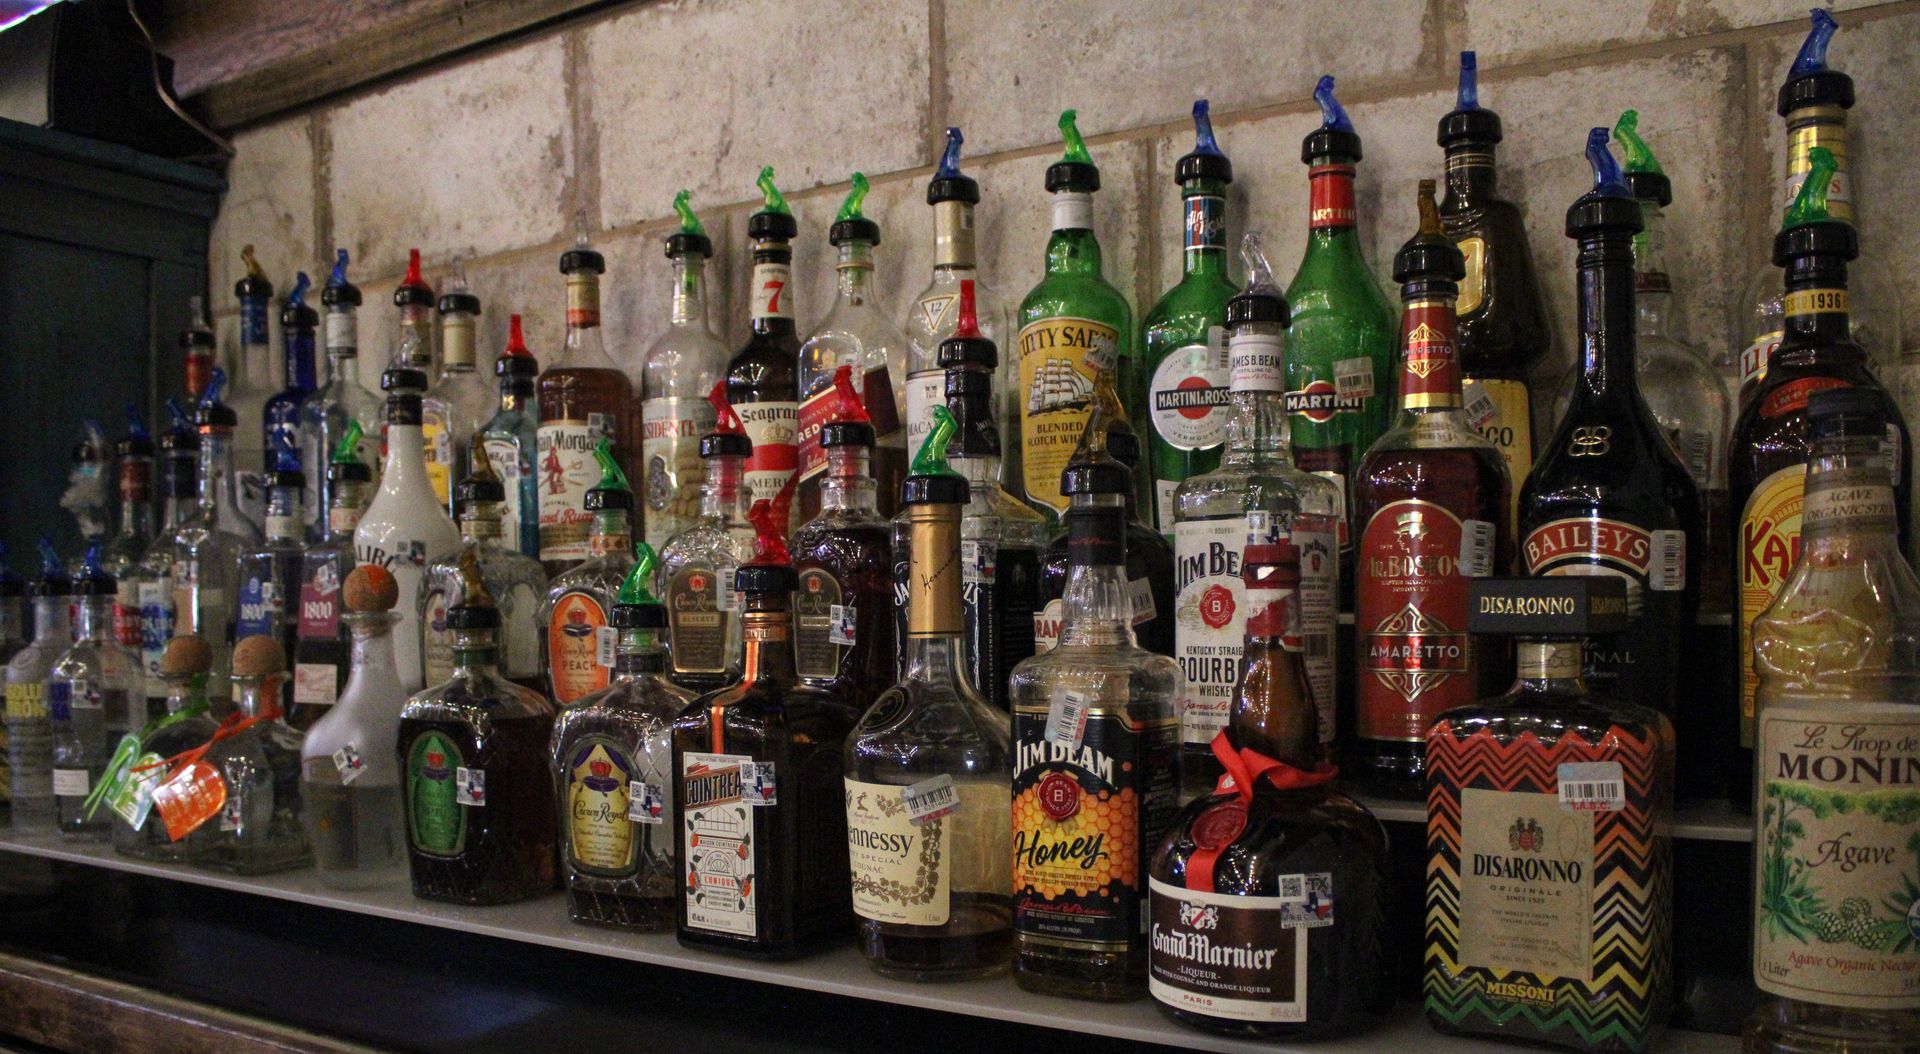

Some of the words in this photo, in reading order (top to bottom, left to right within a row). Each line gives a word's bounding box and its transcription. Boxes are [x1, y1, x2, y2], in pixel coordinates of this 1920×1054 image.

[763, 281, 784, 314] 7
[1811, 293, 1841, 309] 1936
[930, 301, 942, 313] 12
[1062, 326, 1116, 350] SA
[1259, 355, 1281, 369] BEAM
[798, 424, 820, 443] RED
[1037, 422, 1083, 434] BLENDED
[1827, 490, 1873, 503] AGAVE
[1808, 504, 1864, 521] ORGANIC
[1527, 526, 1649, 564] BAILEYS
[1175, 552, 1206, 597] JIM
[304, 602, 333, 619] 1800
[1212, 601, 1221, 613] B
[1479, 595, 1576, 616] DISARONNO
[1186, 646, 1216, 655] KENTUCKY
[1370, 645, 1460, 658] AMARETTO
[563, 660, 597, 671] PEACH
[1199, 685, 1236, 697] WHISKEY
[1794, 726, 1825, 750] Le
[1832, 725, 1891, 759] Sirop
[1897, 735, 1918, 751] de
[1013, 740, 1046, 780] JIM
[1050, 741, 1114, 790] BEAM
[1054, 789, 1063, 802] B
[574, 799, 599, 820] Crown
[599, 802, 626, 824] Royal
[1571, 801, 1611, 811] T.A.B.C.
[1015, 830, 1108, 870] Honey
[1806, 831, 1897, 874] Agave
[861, 854, 902, 866] SPECIAL
[1473, 854, 1583, 884] DISARONNO
[704, 874, 735, 888] L'UNIQUE
[1306, 877, 1328, 890] TX
[1490, 884, 1562, 897] ORIGINALE
[1152, 922, 1188, 957] Grand
[1187, 931, 1278, 970] Marnier
[1768, 961, 1790, 977] Liter
[1787, 950, 1823, 969] Agave
[1826, 956, 1877, 977] Organic
[1173, 973, 1196, 985] COGNAC
[1195, 978, 1209, 987] AND
[1210, 981, 1237, 992] ORANGE
[1239, 984, 1272, 994] LIQUEUR
[1183, 994, 1214, 1006] PARIS
[1486, 981, 1556, 1003] MISSONI
